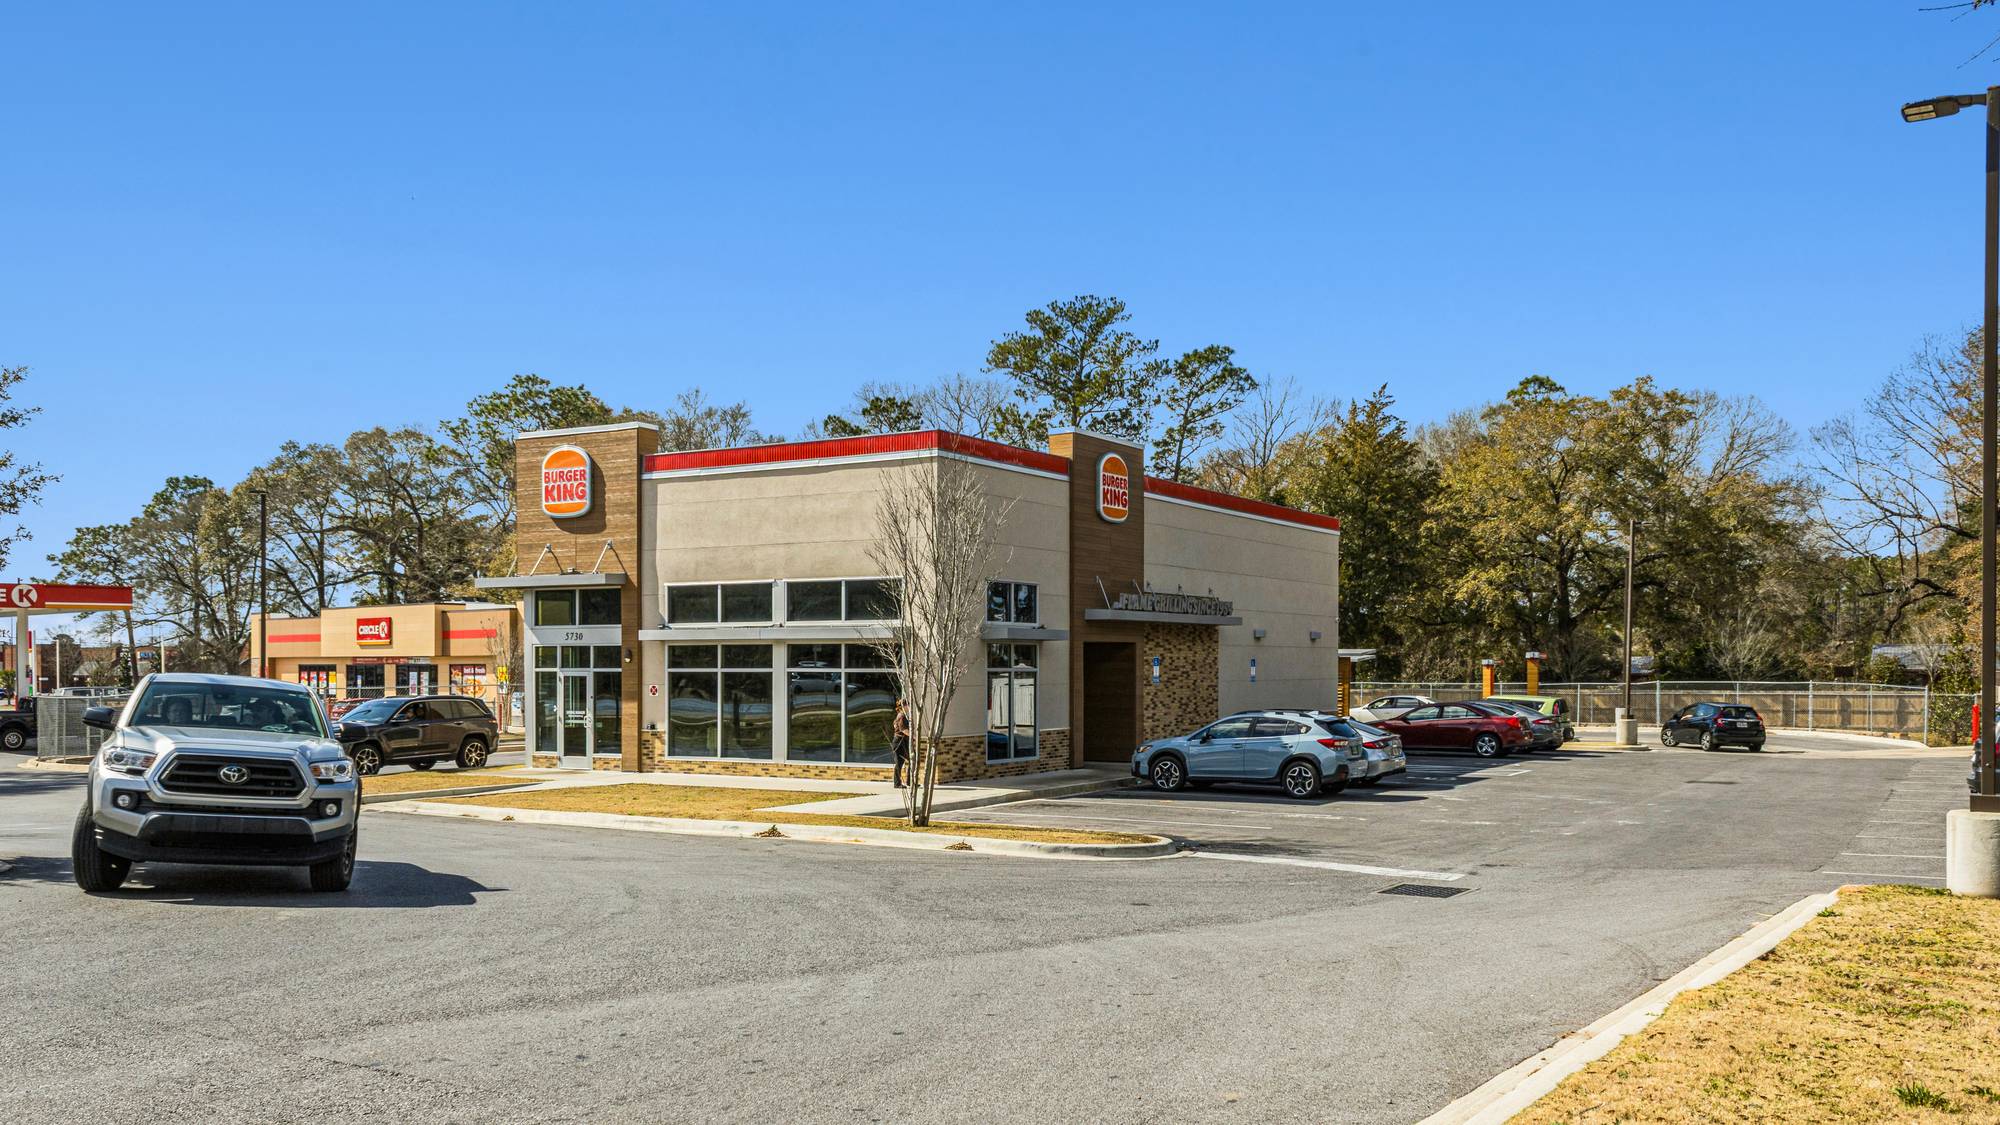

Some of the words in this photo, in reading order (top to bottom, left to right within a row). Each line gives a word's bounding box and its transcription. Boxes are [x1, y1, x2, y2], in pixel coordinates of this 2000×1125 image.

[543, 469, 586, 484] BURGER
[1102, 473, 1128, 490] BURGER
[544, 482, 587, 502] KING
[1102, 487, 1128, 509] KING
[17, 587, 36, 607] K
[1122, 593, 1154, 611] FLAME
[1154, 594, 1193, 614] GRILLING
[1193, 597, 1217, 616] SINCE
[565, 632, 584, 640] 5730
